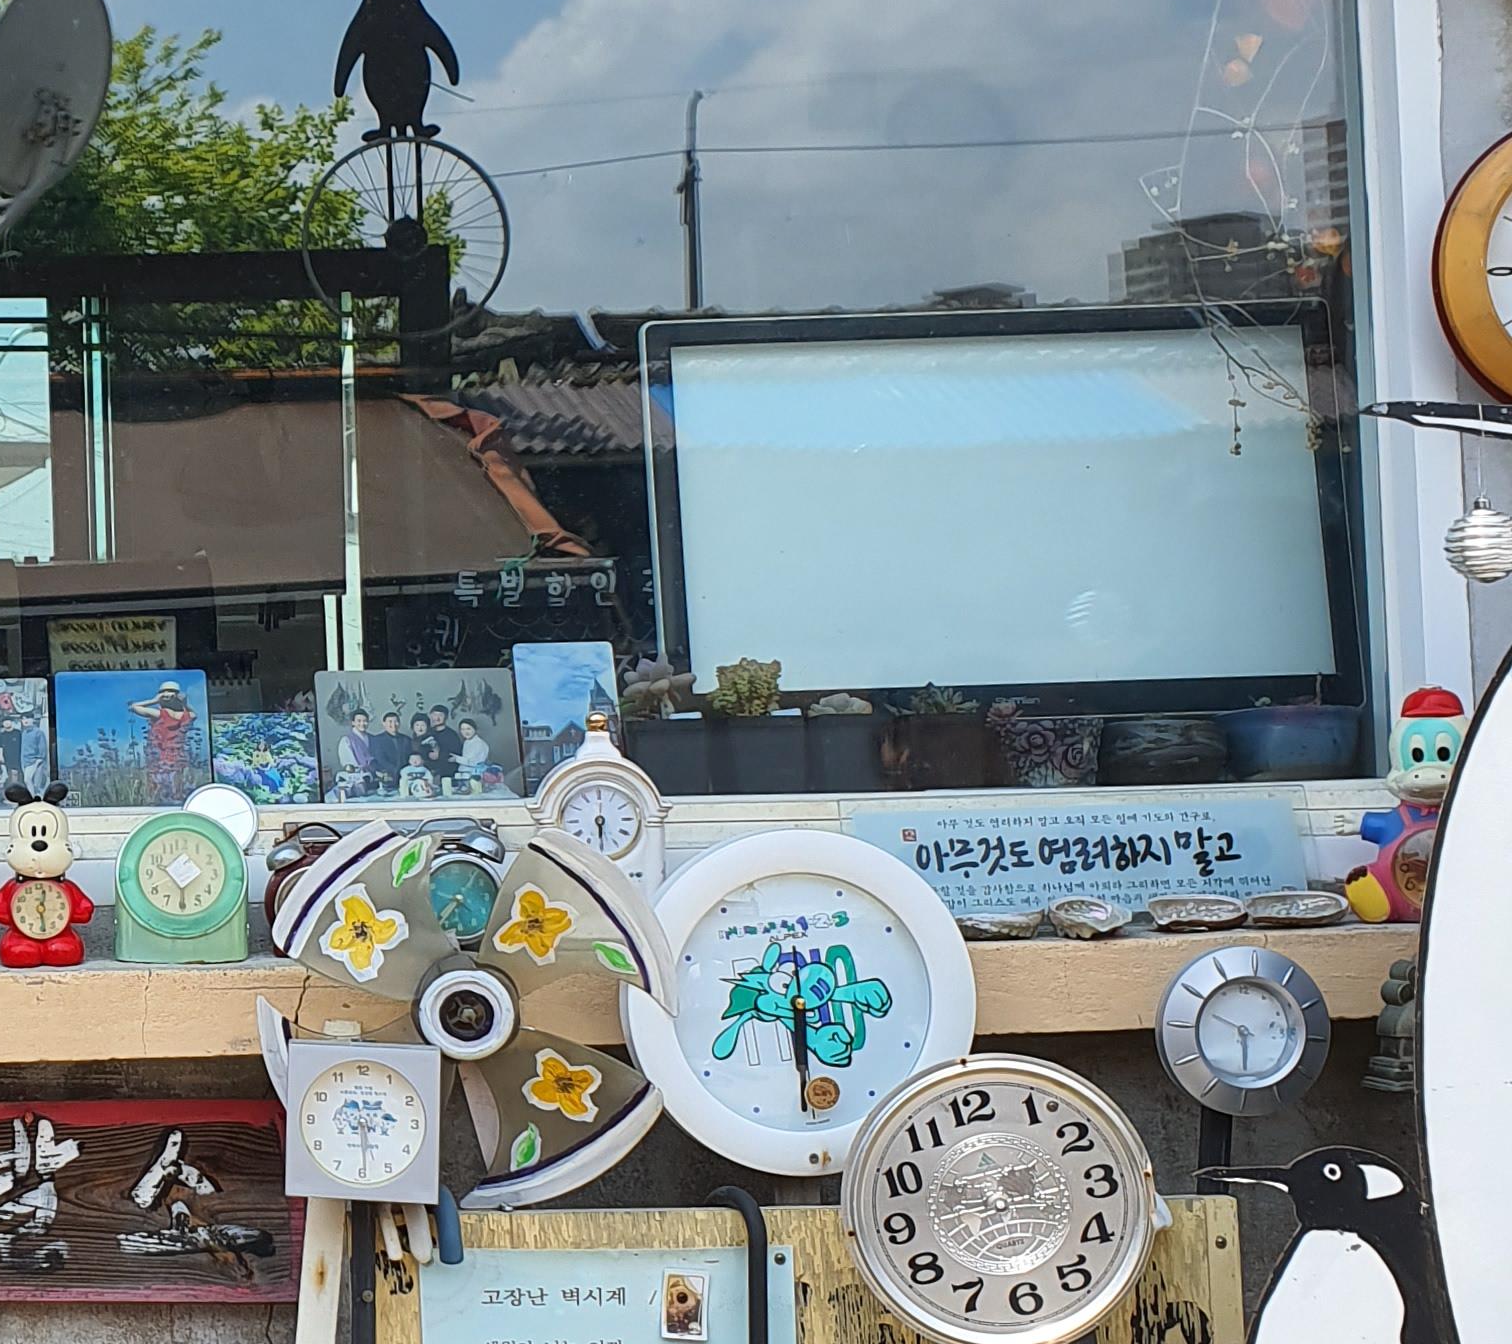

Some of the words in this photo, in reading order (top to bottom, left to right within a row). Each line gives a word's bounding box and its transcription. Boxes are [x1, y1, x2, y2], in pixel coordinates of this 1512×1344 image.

[1064, 814, 1085, 826] 오직
[1090, 813, 1112, 825] 모든
[916, 835, 1035, 879] 아무것도
[1037, 833, 1172, 875] 염려하지
[1173, 826, 1242, 878] 말고
[1176, 877, 1199, 889] 모든
[972, 896, 1016, 907] 그리스도
[948, 1089, 996, 1128] 12
[1021, 1091, 1043, 1126] 1
[905, 1116, 946, 1153] 11
[1055, 1120, 1095, 1156] 2
[881, 1160, 923, 1199] 10
[1083, 1163, 1119, 1199] 3
[882, 1211, 917, 1245] 9
[1079, 1210, 1116, 1245] 4
[907, 1251, 945, 1285] 8
[1055, 1253, 1093, 1293] 5
[480, 1286, 550, 1307] 고장난
[560, 1286, 627, 1307] 벽시계
[951, 1276, 985, 1313] 7
[1007, 1281, 1045, 1316] 6
